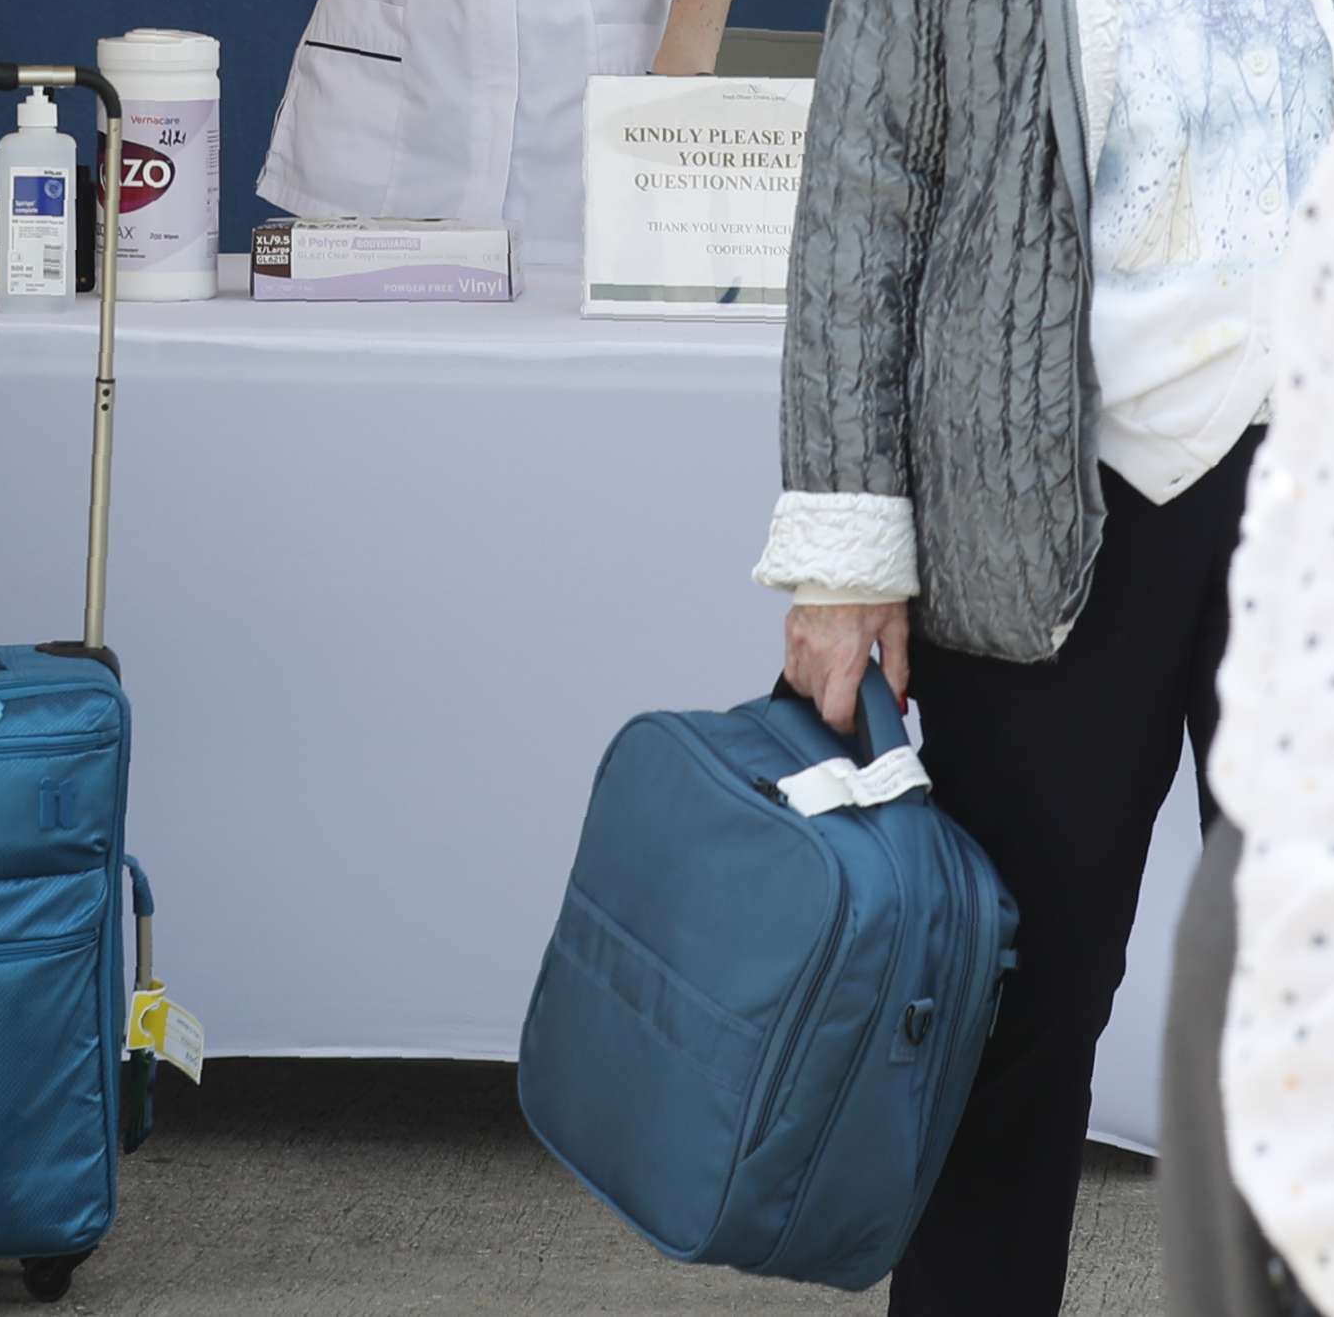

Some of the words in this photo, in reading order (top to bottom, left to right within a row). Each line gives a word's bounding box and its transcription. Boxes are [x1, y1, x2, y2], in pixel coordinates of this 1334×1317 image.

[130, 115, 180, 125] Vernacare
[623, 127, 703, 144] KINDLY
[708, 128, 785, 146] PLEASE
[679, 151, 736, 168] YOUR
[741, 152, 803, 169] HEAL
[119, 158, 172, 189] ZO
[647, 221, 689, 234] THANK
[692, 222, 717, 234] YOU
[720, 223, 754, 235] VERY
[755, 223, 793, 236] MUCH
[256, 235, 291, 246] XL/9.5
[256, 246, 290, 255] X/Large
[384, 284, 426, 293] POWDER
[428, 284, 452, 293] FREE
[458, 277, 503, 295] Vinyl
